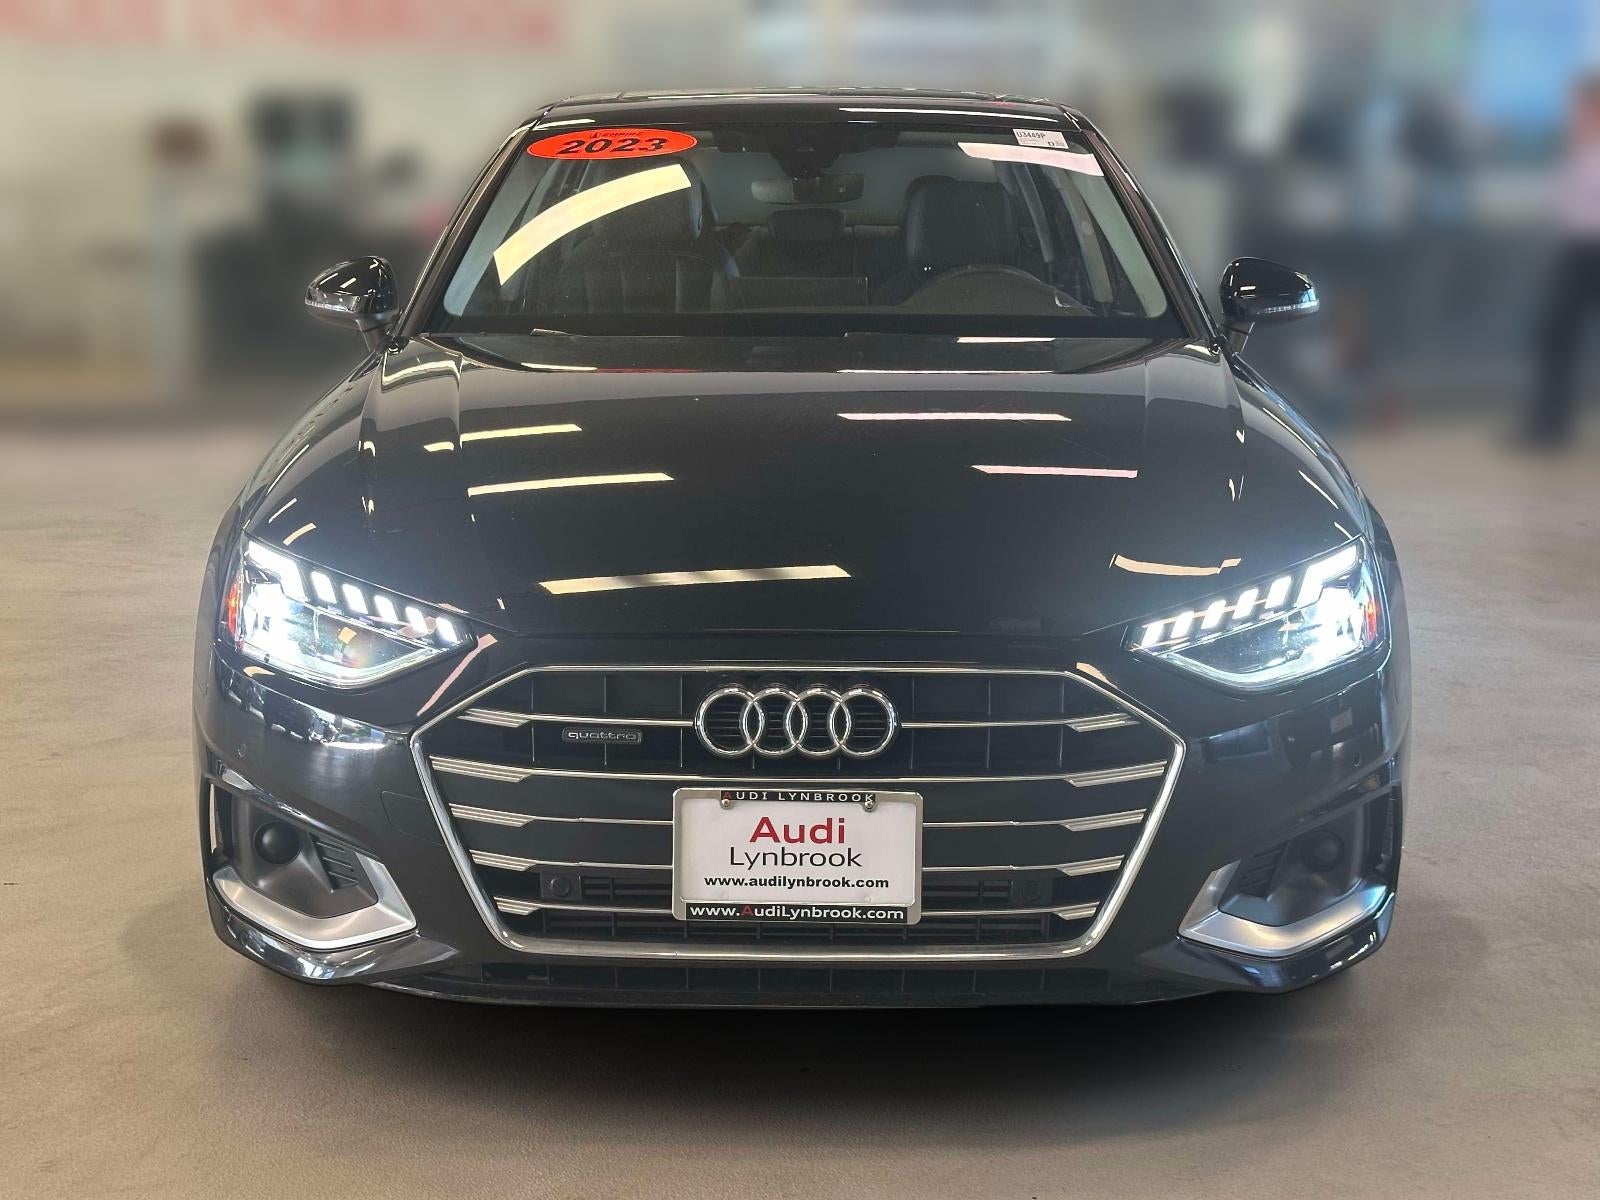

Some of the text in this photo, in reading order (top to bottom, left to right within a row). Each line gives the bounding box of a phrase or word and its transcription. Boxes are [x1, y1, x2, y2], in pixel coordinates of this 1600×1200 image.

[556, 138, 667, 155] 2023
[568, 732, 637, 740] quattro
[722, 791, 874, 802] AUDI LYNBROOK
[750, 816, 845, 844] Audi
[730, 847, 862, 870] Lynbrook
[704, 876, 889, 889] www.audilynbrook.com
[690, 905, 904, 920] www.AudiLynbrook.com
